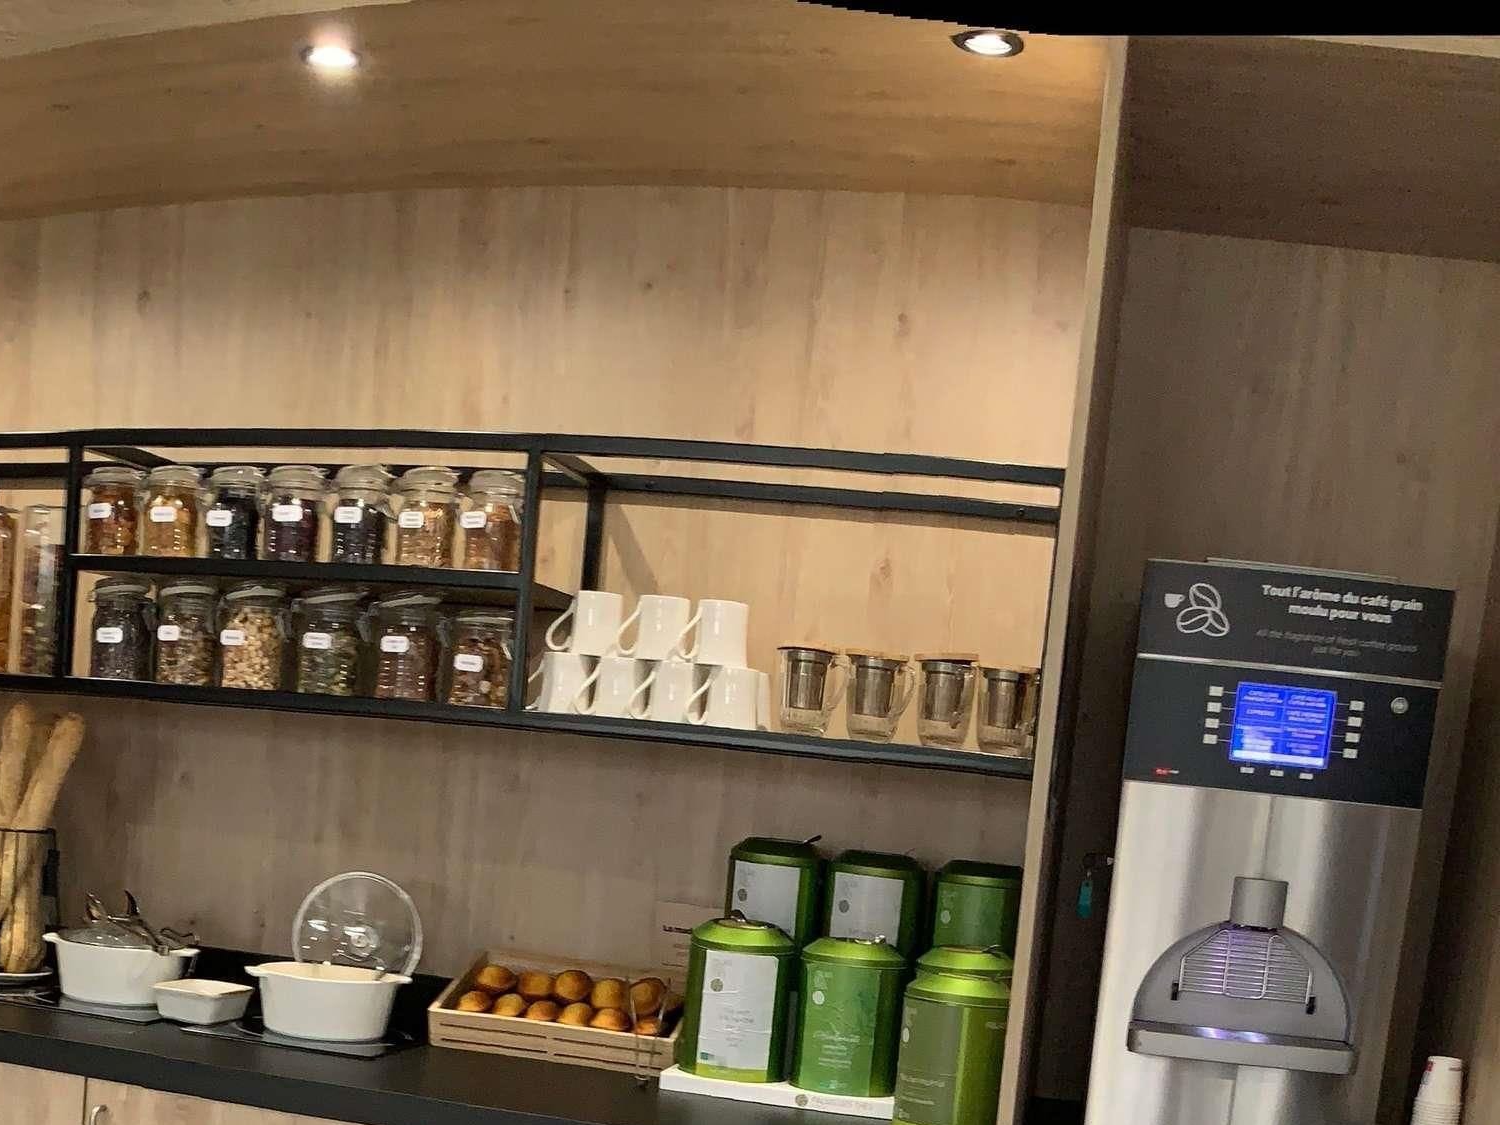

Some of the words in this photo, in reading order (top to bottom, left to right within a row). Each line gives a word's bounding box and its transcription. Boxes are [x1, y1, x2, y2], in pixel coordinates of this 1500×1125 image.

[1262, 584, 1292, 598] Tout
[1342, 592, 1359, 604] du
[1360, 595, 1390, 607] café
[1390, 598, 1424, 612] grain
[1288, 604, 1329, 617] moulu
[1329, 608, 1360, 621] pour
[1361, 612, 1393, 624] vous
